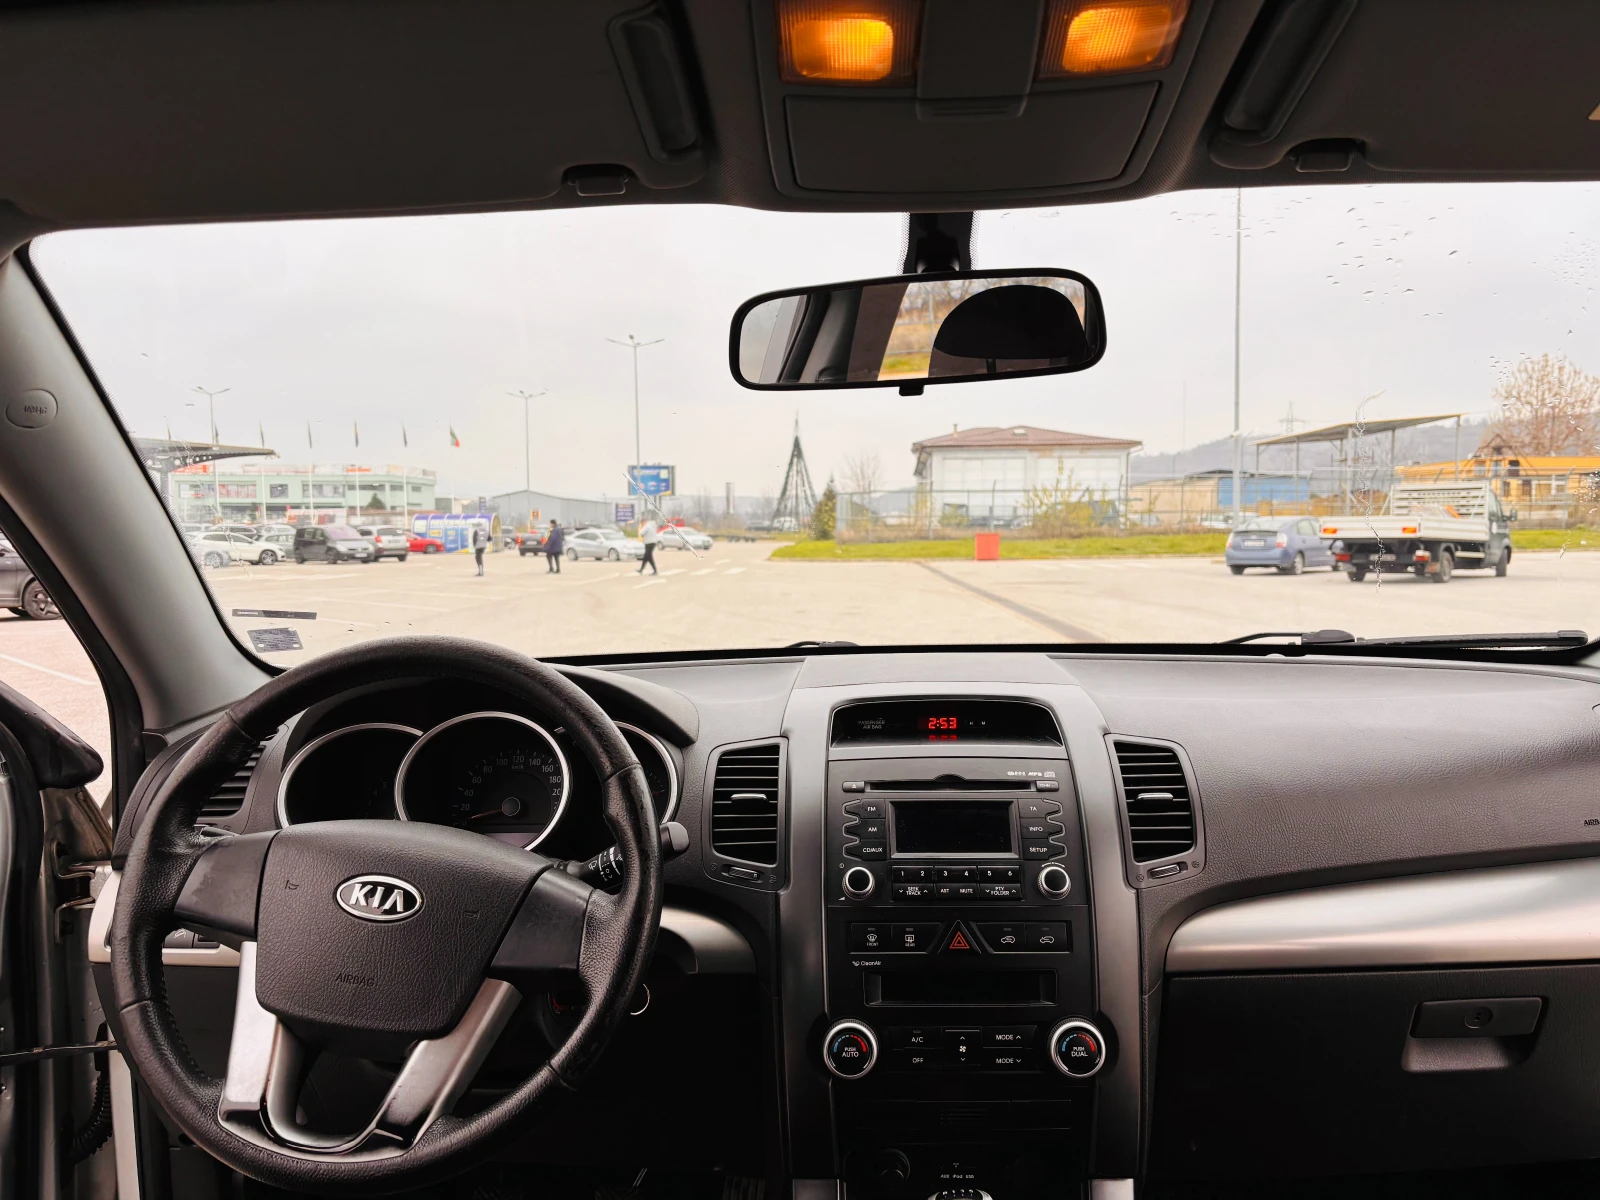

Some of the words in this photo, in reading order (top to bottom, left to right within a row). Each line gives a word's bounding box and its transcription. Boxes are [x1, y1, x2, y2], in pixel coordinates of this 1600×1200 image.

[928, 717, 957, 730] 2:53
[542, 764, 554, 772] 160
[349, 884, 404, 912] KIA
[336, 973, 375, 987] AIRBAG
